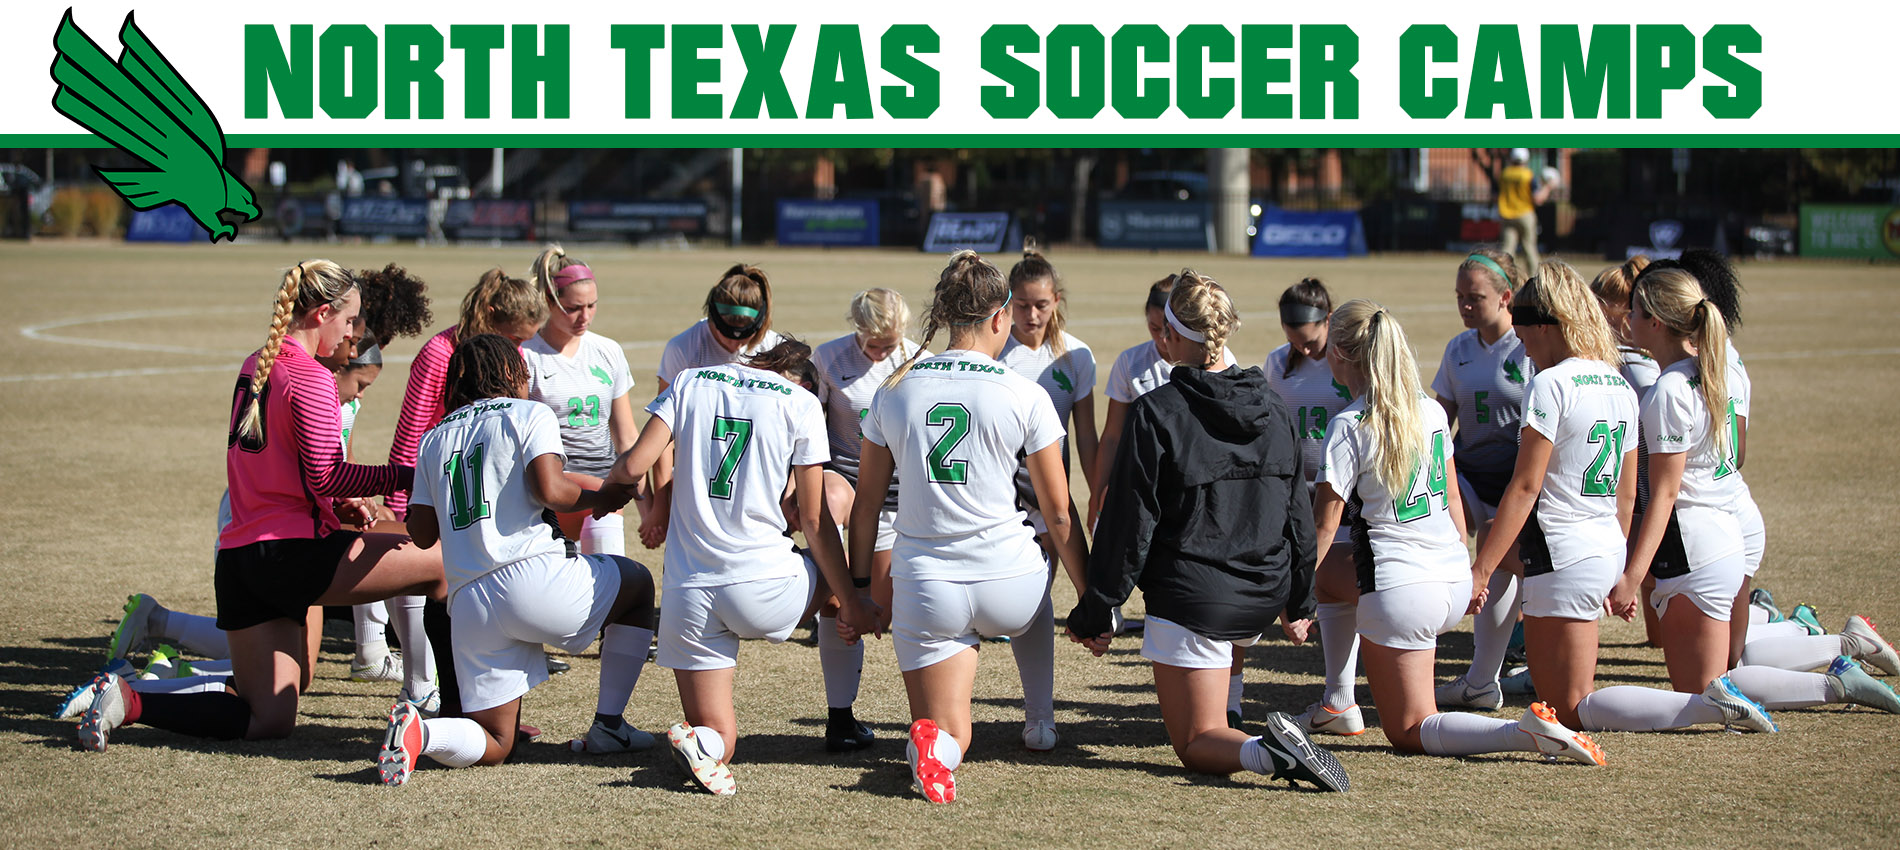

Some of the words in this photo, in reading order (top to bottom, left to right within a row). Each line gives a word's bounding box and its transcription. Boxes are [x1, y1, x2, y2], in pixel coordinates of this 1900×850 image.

[568, 395, 600, 426] 23
[926, 402, 971, 485] 2
[1298, 406, 1328, 439] 13
[1475, 391, 1489, 423] 5
[444, 443, 490, 531] 11
[709, 416, 753, 500] 7
[1393, 429, 1449, 523] 24
[1580, 420, 1627, 497] 21
